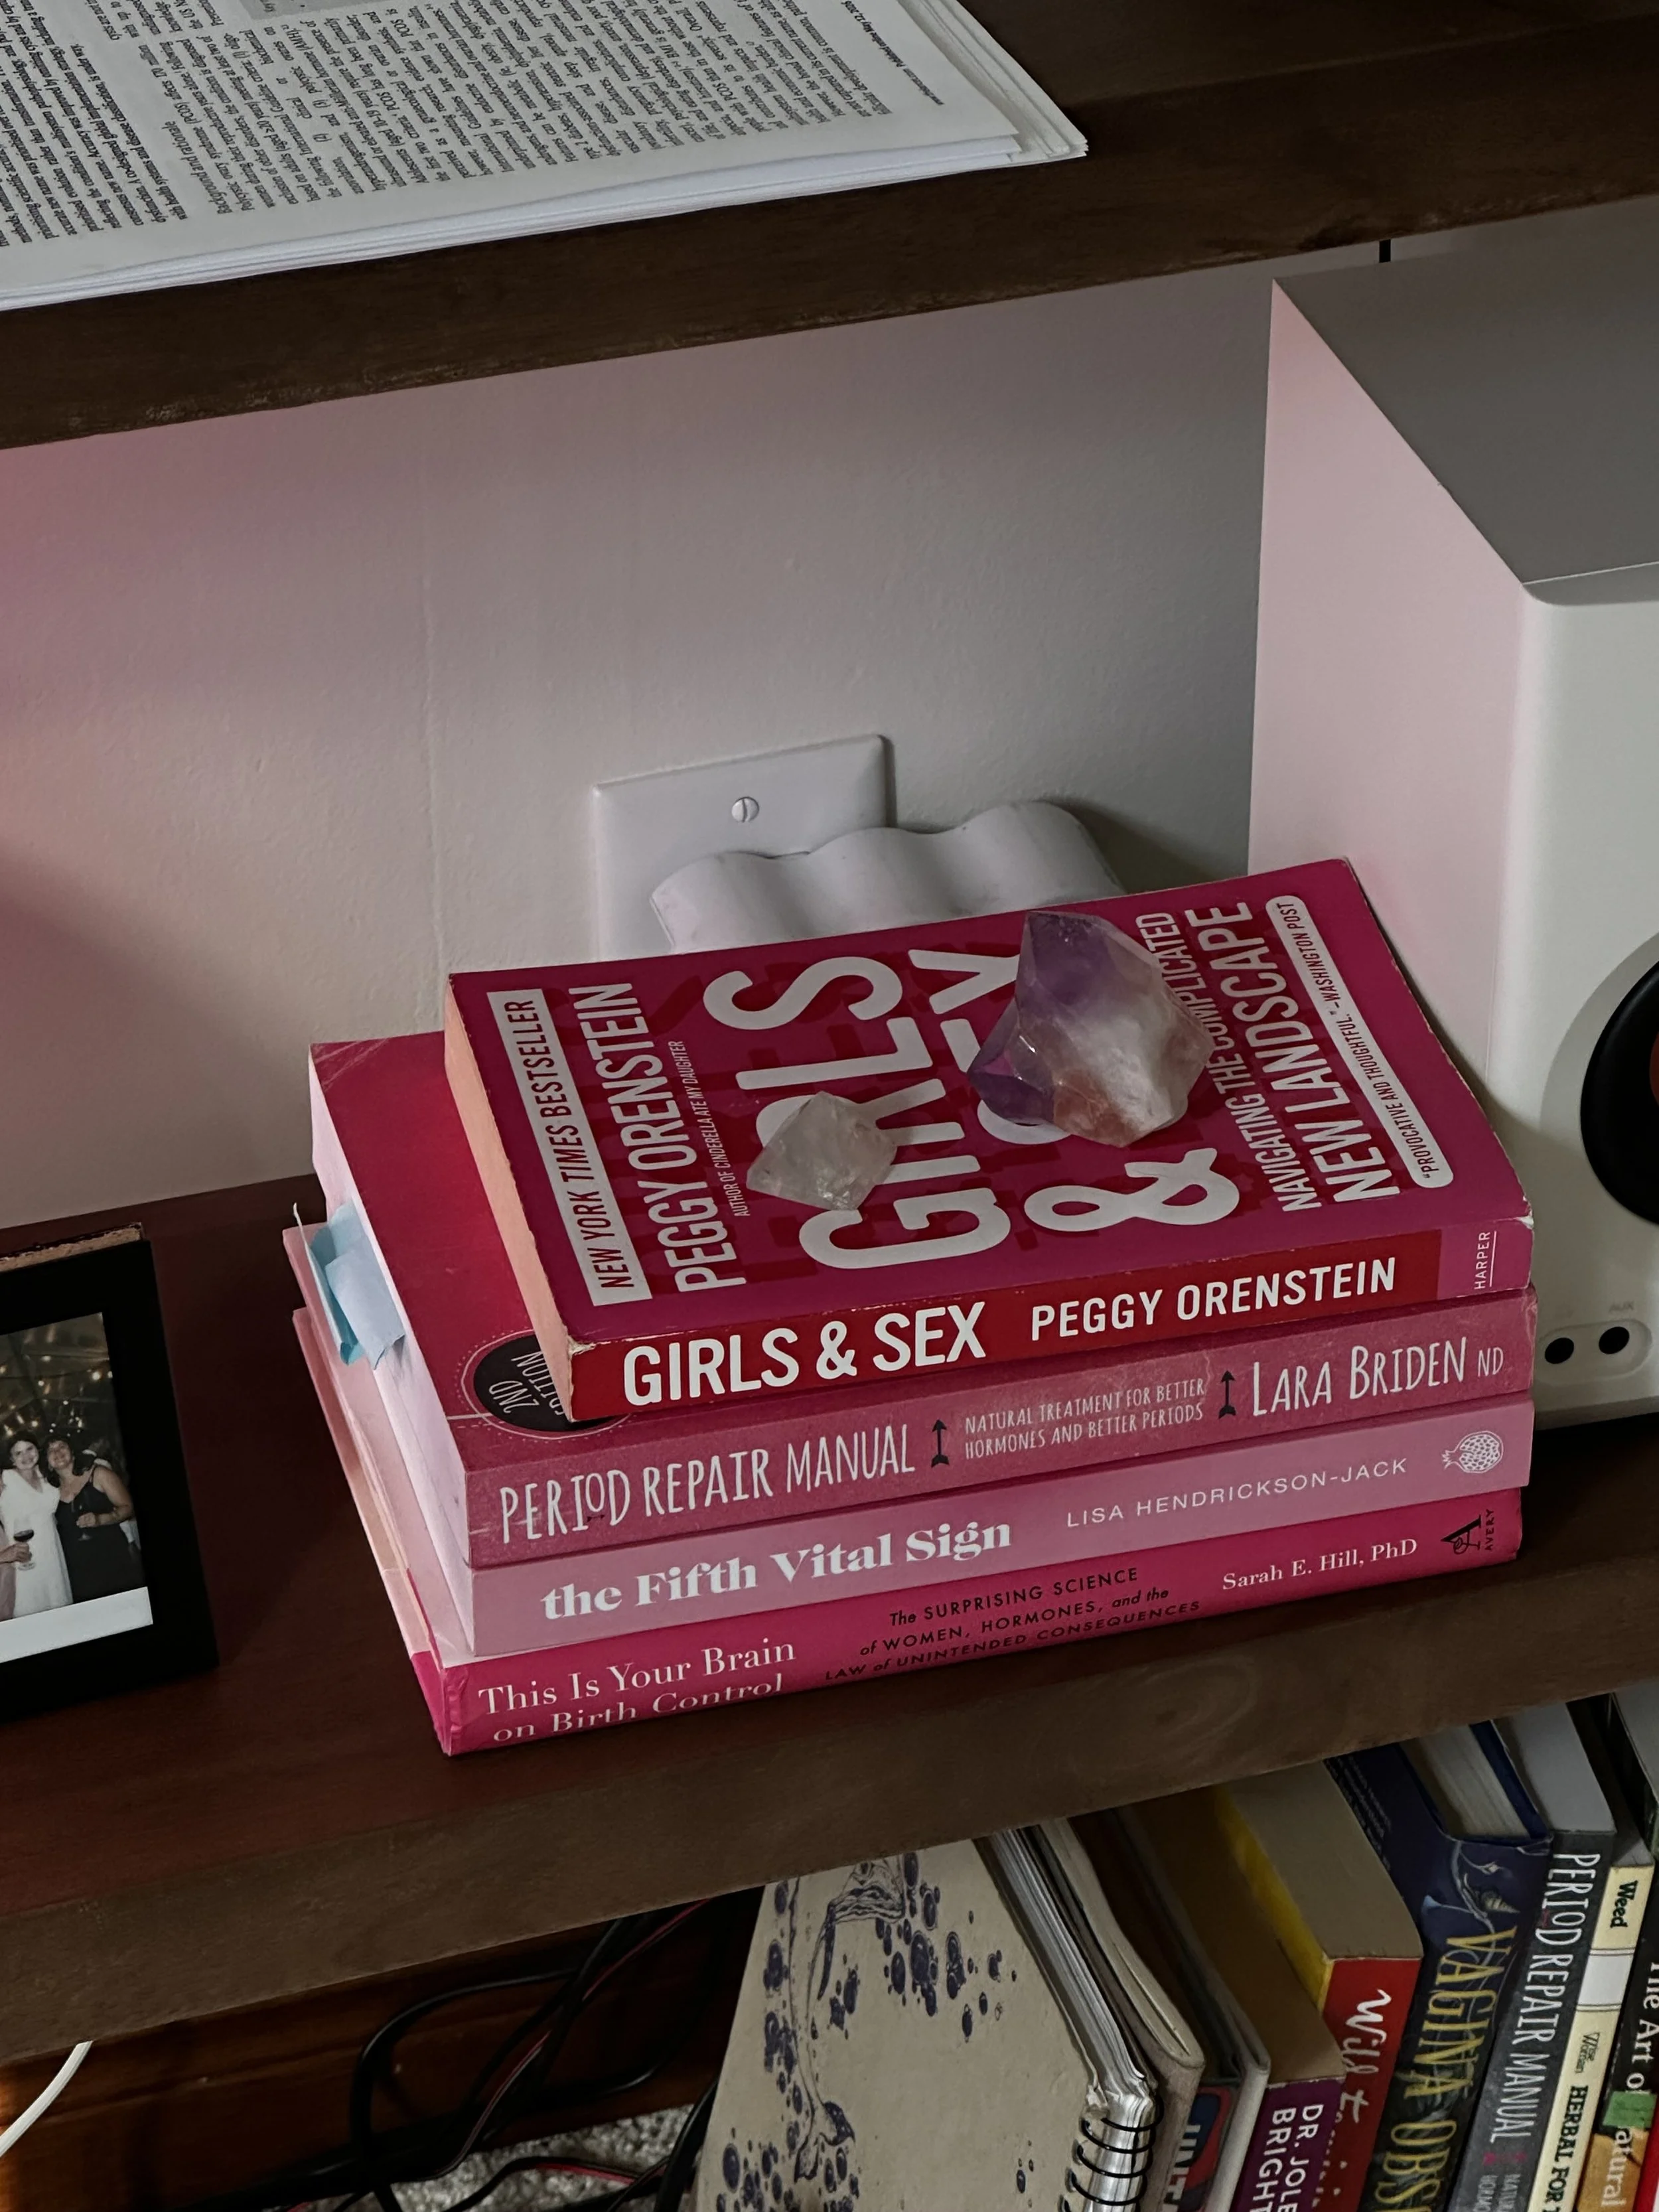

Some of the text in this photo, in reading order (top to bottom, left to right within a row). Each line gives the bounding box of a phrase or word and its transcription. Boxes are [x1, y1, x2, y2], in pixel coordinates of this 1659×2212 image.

[390, 19, 414, 37] PCOS
[749, 12, 775, 37] features
[859, 21, 874, 33] May
[311, 29, 340, 55] presence
[407, 39, 425, 52] that
[879, 46, 905, 67] Published
[77, 58, 96, 75] under
[328, 56, 344, 66] the
[420, 54, 443, 74] shown
[785, 61, 810, 79] broad
[161, 80, 182, 100] affects
[338, 68, 361, 89] require
[437, 77, 455, 93] have
[806, 80, 820, 90] the
[173, 102, 202, 124] (PCOS)
[224, 104, 239, 115] the
[352, 90, 379, 108] years)
[451, 96, 481, 129] Guidelines
[816, 91, 845, 117] However,
[129, 146, 149, 159] and
[192, 126, 222, 159] syndrome
[378, 128, 405, 146] (aged
[474, 132, 514, 173] International
[142, 160, 168, 185] systems
[161, 120, 233, 214] Background and rationale
[214, 162, 233, 179] ovary
[253, 149, 272, 166] other
[155, 185, 179, 206] health
[226, 181, 255, 211] Polycystic
[271, 175, 299, 204] exclusion
[169, 205, 188, 220] with
[1277, 903, 1305, 930] POST
[1185, 902, 1400, 1203] NEW LANDSCAPE
[1206, 1053, 1256, 1094] THE
[1373, 1080, 1394, 1100] AND
[504, 1000, 634, 1288] NEW YORK TIMES BESTSELLER
[569, 983, 747, 1292] PEGGY ORENSTEIN
[668, 1041, 751, 1217] AUTHOR OF CINDERELLA ATE MY DAUGHTER
[1386, 1102, 1439, 1178] “PROVOCATIVE
[1226, 1093, 1322, 1212] NAVIGATING
[1024, 1148, 1240, 1232] &
[624, 1231, 1490, 1406] GIRLS & SEX PEGGY ORENSTEIN HARPER
[1253, 1336, 1504, 1416] LARA BRIDEN ND
[488, 1380, 540, 1413] 2ND
[965, 1378, 1205, 1434] NATURAL TREATMENT FOR BETTER
[965, 1403, 1203, 1460] HORMONES AND BETTER PERIODS
[500, 1424, 916, 1544] PERIOD REPAIR MANUAL
[1067, 1457, 1408, 1528] LISA HENDRICKSON-JACK
[1484, 1509, 1495, 1551] AVERY
[540, 1521, 1011, 1620] the Fifth Vital Sign
[1222, 1538, 1418, 1590] Sarah E. Hill, PhD
[890, 1567, 1139, 1627] The SURPRISING SCIENCE
[860, 1587, 1169, 1657] of WOMEN, HORMONES, and the
[825, 1600, 1200, 1681] LAW of UNINTENDED CONSEQUENCES
[478, 1637, 796, 1716] This Is Your Brain
[493, 1672, 782, 1742] on Birth Control
[1610, 1880, 1638, 1928] Weed
[1490, 1854, 1601, 2144] PERIOD REPAIR MANUAL
[1632, 2019, 1659, 2064] Art
[1368, 1926, 1518, 2212] VAGINA OBS
[1293, 2104, 1324, 2148] DR.
[1554, 2085, 1589, 2162] HERBAL
[1545, 2167, 1569, 2203] FOR
